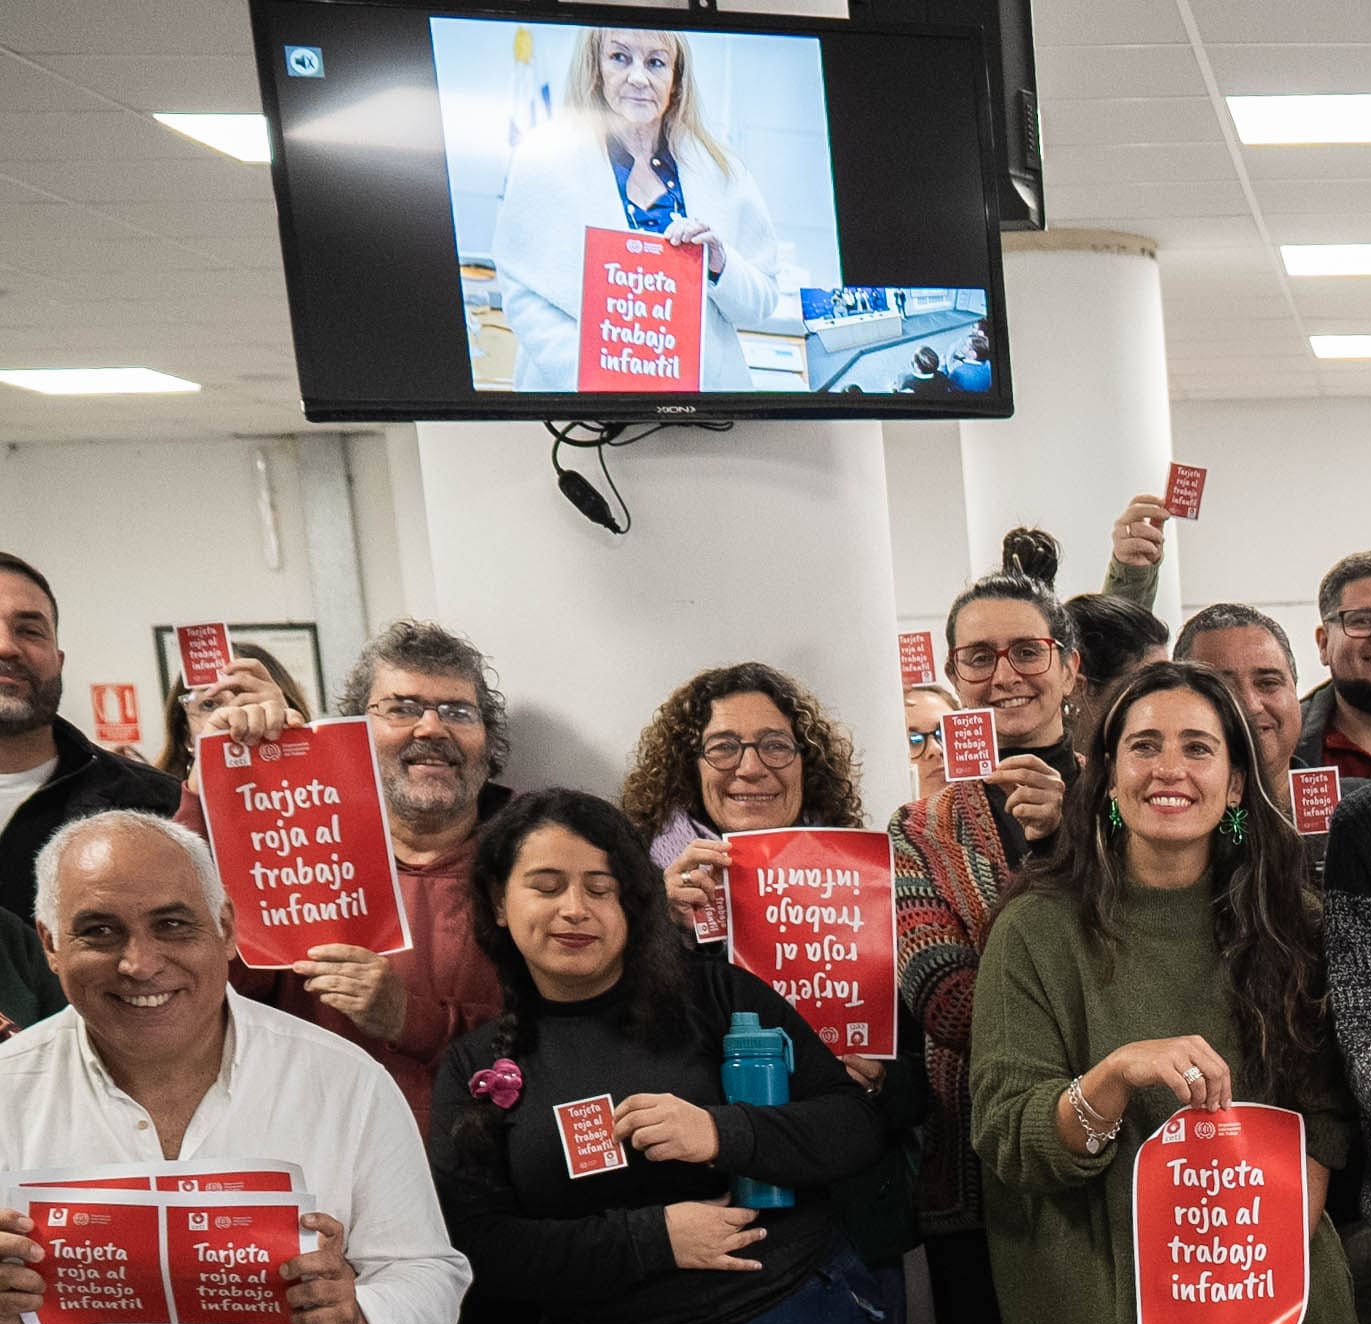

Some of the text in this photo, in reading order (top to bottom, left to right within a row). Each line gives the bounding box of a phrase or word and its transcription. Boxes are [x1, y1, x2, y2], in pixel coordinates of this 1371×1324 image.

[603, 262, 677, 295] Tarjeta
[606, 292, 673, 322] roja al
[599, 318, 676, 355] trabajo
[600, 347, 681, 380] infantil
[952, 715, 983, 727] Tarjeta
[955, 726, 982, 739] roja al
[954, 739, 985, 750] trabajo
[955, 749, 989, 761] infantil
[1300, 774, 1328, 784] Tarjeta
[1303, 784, 1327, 796] roja al
[235, 778, 341, 818] Tarjeta
[1302, 796, 1331, 806] trabajo
[250, 813, 342, 857] roja al
[249, 852, 355, 891] trabajo
[756, 866, 861, 900] infantil
[259, 887, 368, 927] infantil
[765, 896, 866, 934] trabajo
[775, 941, 858, 971] roja al
[568, 1104, 602, 1117] Tarjeta
[573, 1114, 603, 1131] roja al
[575, 1128, 607, 1143] trabajo
[577, 1139, 613, 1155] infantil
[1166, 1157, 1265, 1197] Tarjeta
[1174, 1195, 1261, 1234] roja al
[48, 1238, 129, 1265] Tarjeta
[192, 1241, 271, 1269] Tarjeta
[1167, 1234, 1268, 1271] trabajo
[57, 1263, 126, 1282] roja al
[199, 1268, 267, 1286] roja al
[54, 1281, 134, 1301] trabajo
[197, 1285, 273, 1301] trabajo
[1171, 1268, 1275, 1303] infantil
[59, 1295, 143, 1310] infantil
[201, 1298, 281, 1313] infantil
